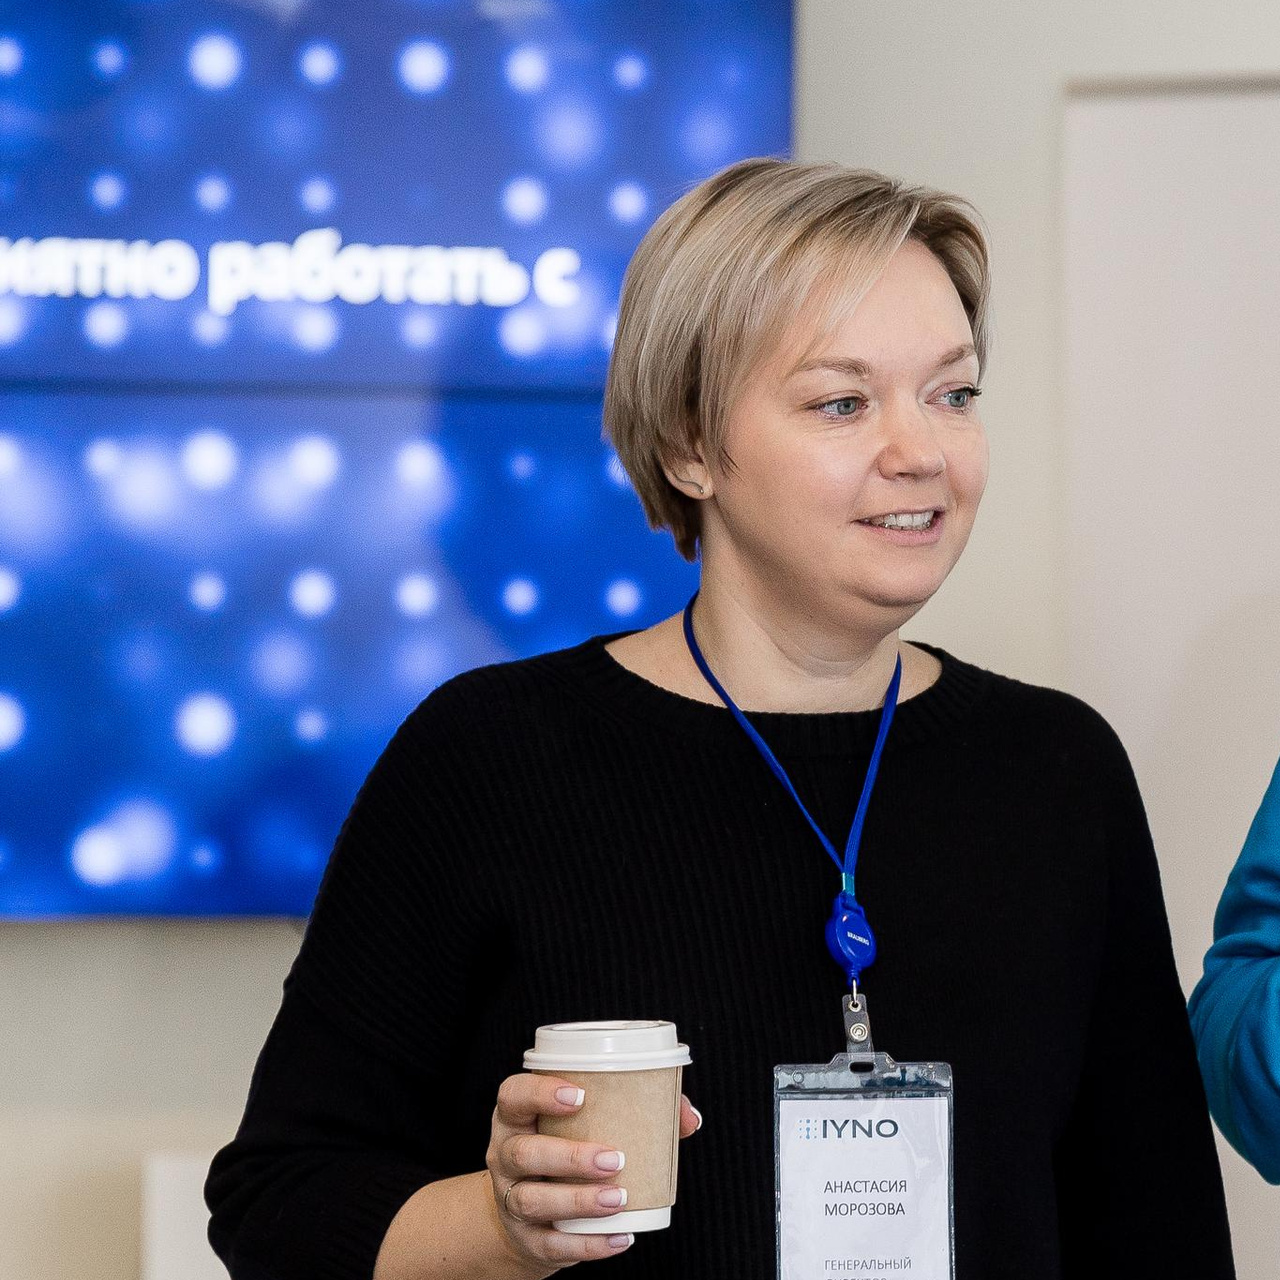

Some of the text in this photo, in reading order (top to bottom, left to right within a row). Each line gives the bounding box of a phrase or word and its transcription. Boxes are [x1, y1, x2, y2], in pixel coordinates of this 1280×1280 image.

[208, 229, 529, 316] работать
[533, 248, 581, 308] с
[822, 1118, 899, 1139] IYNO
[823, 1179, 907, 1194] АНАСТАСИЯ
[824, 1202, 906, 1216] МОРОЗОВА
[824, 1256, 912, 1271] ГЕНЕРАЛЬНЫЙ
